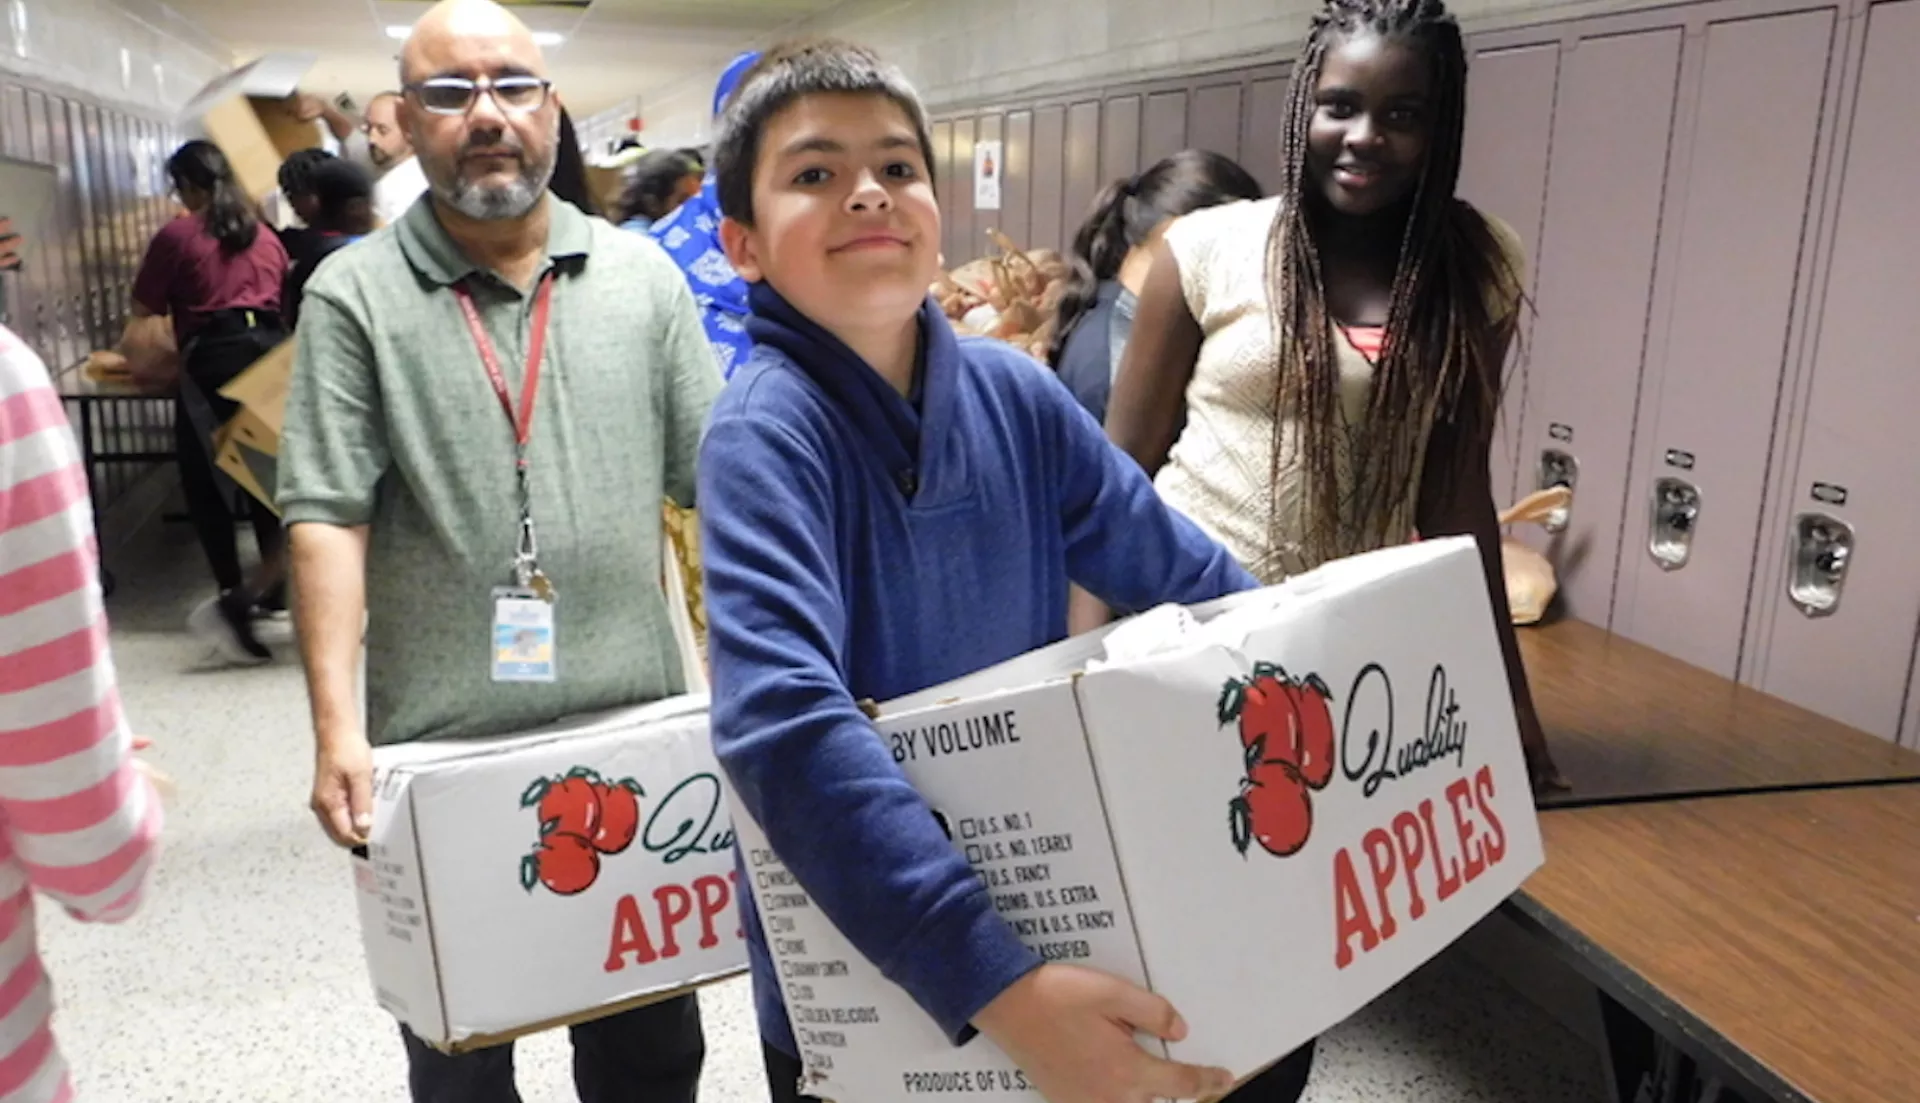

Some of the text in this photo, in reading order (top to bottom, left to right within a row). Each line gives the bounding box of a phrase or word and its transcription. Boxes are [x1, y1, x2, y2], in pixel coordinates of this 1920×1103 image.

[890, 710, 1021, 763] BY VOLUME
[1341, 663, 1467, 798] Quality
[976, 815, 1003, 837] U.S.
[982, 841, 1009, 861] U.S.
[988, 863, 1051, 887] U.S. FANCY
[1333, 764, 1507, 970] APPLES
[1034, 888, 1060, 908] U.S.
[1060, 884, 1099, 906] EXTRA
[603, 870, 747, 972] APP
[1008, 917, 1038, 935] NCY
[1050, 912, 1076, 933] U.S.
[1076, 909, 1116, 931] FANCY
[902, 1070, 974, 1093] PRODUCE
[975, 1069, 995, 1092] OF
